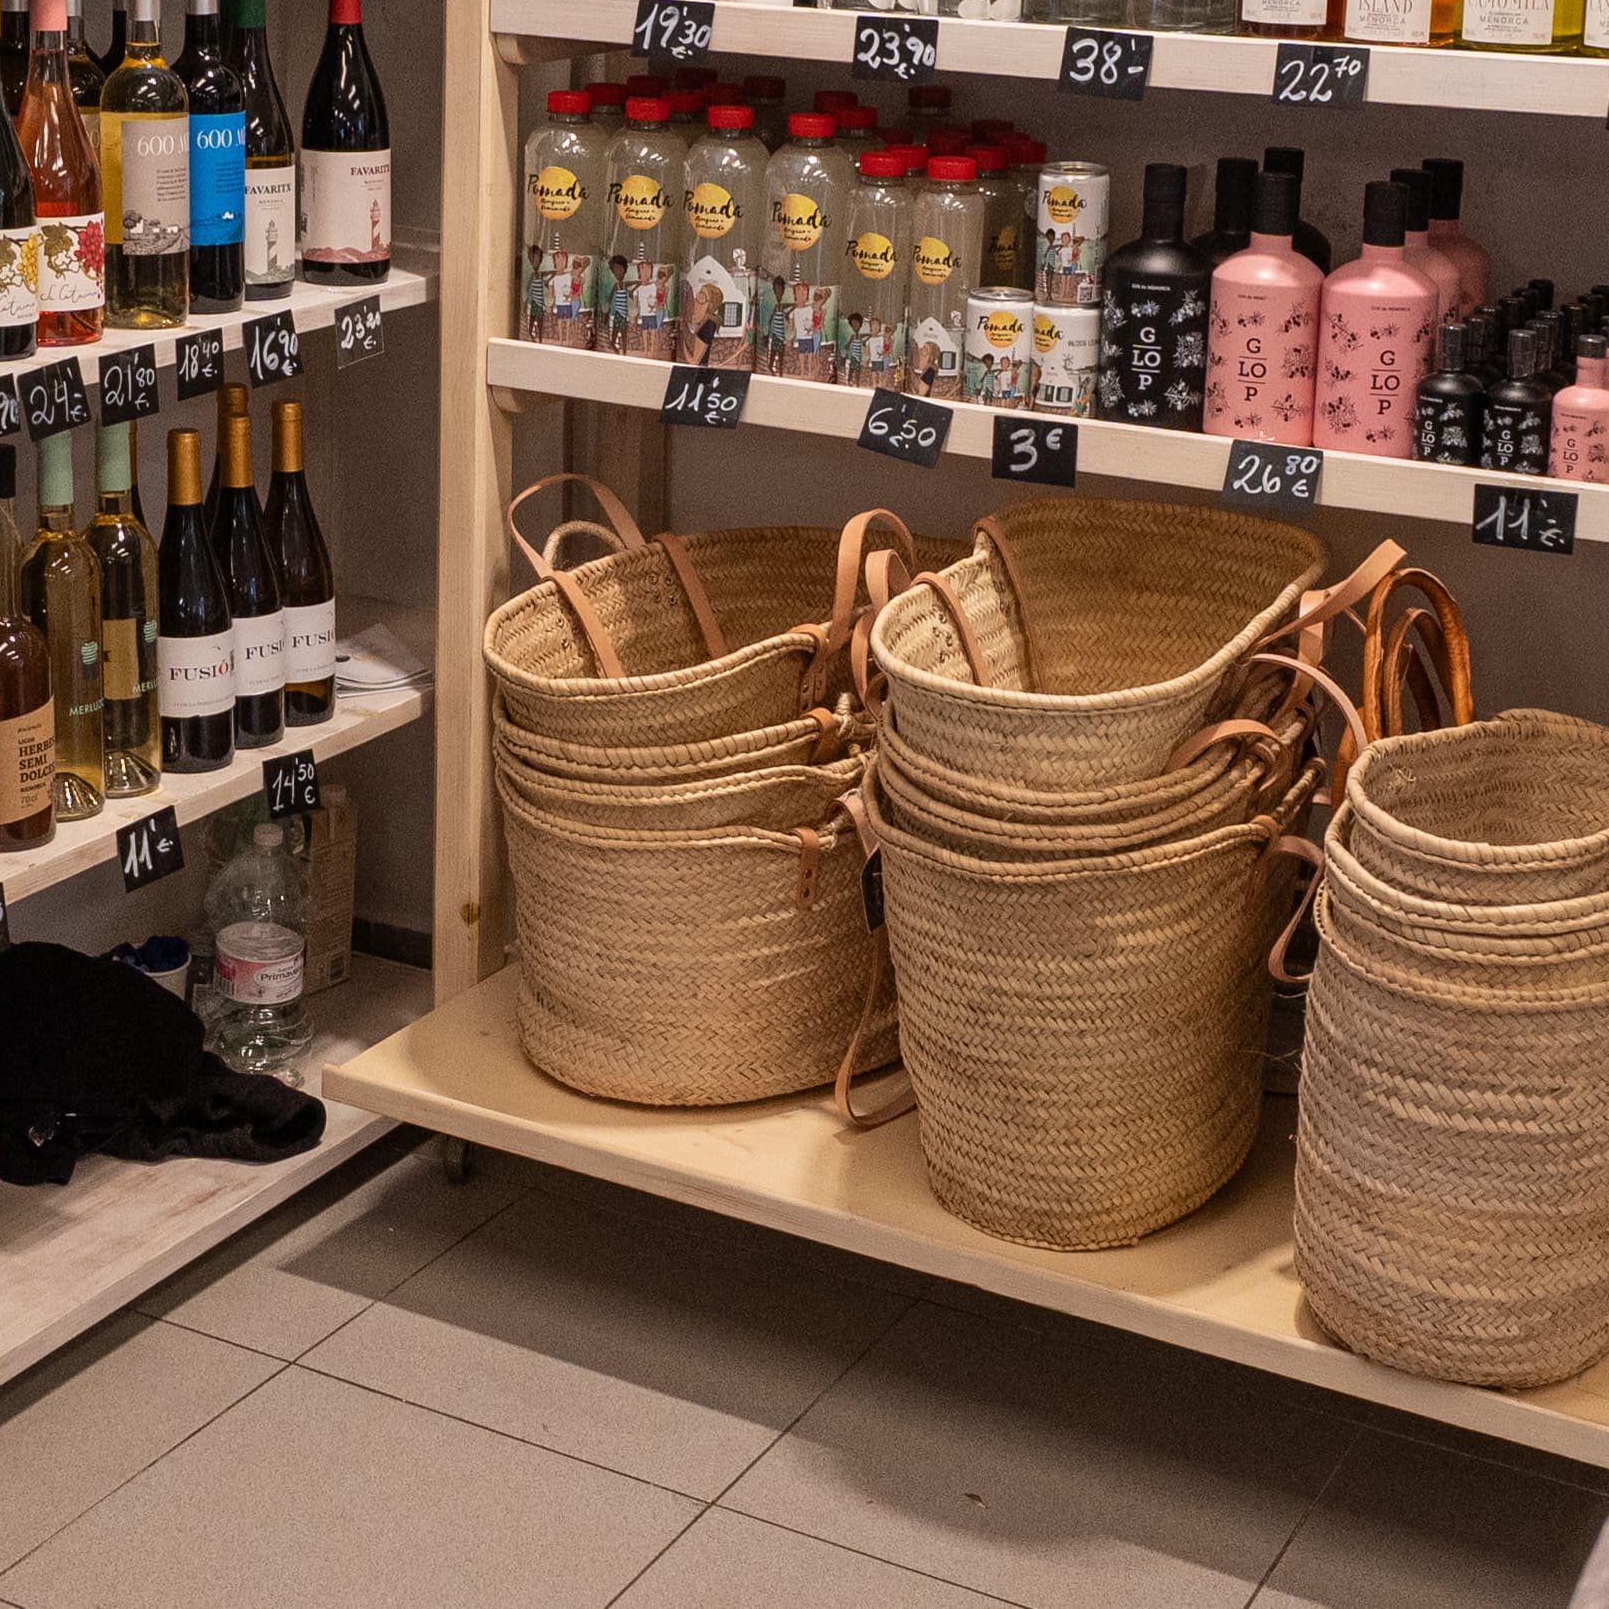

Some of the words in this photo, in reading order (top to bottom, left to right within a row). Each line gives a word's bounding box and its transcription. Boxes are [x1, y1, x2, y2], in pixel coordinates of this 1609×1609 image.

[527, 173, 590, 201] Pomada
[606, 182, 673, 209] Pomada
[682, 189, 745, 219] Pomada
[771, 200, 832, 229] Pomada
[845, 240, 898, 264] Pomada
[18, 754, 48, 772] SEMI
